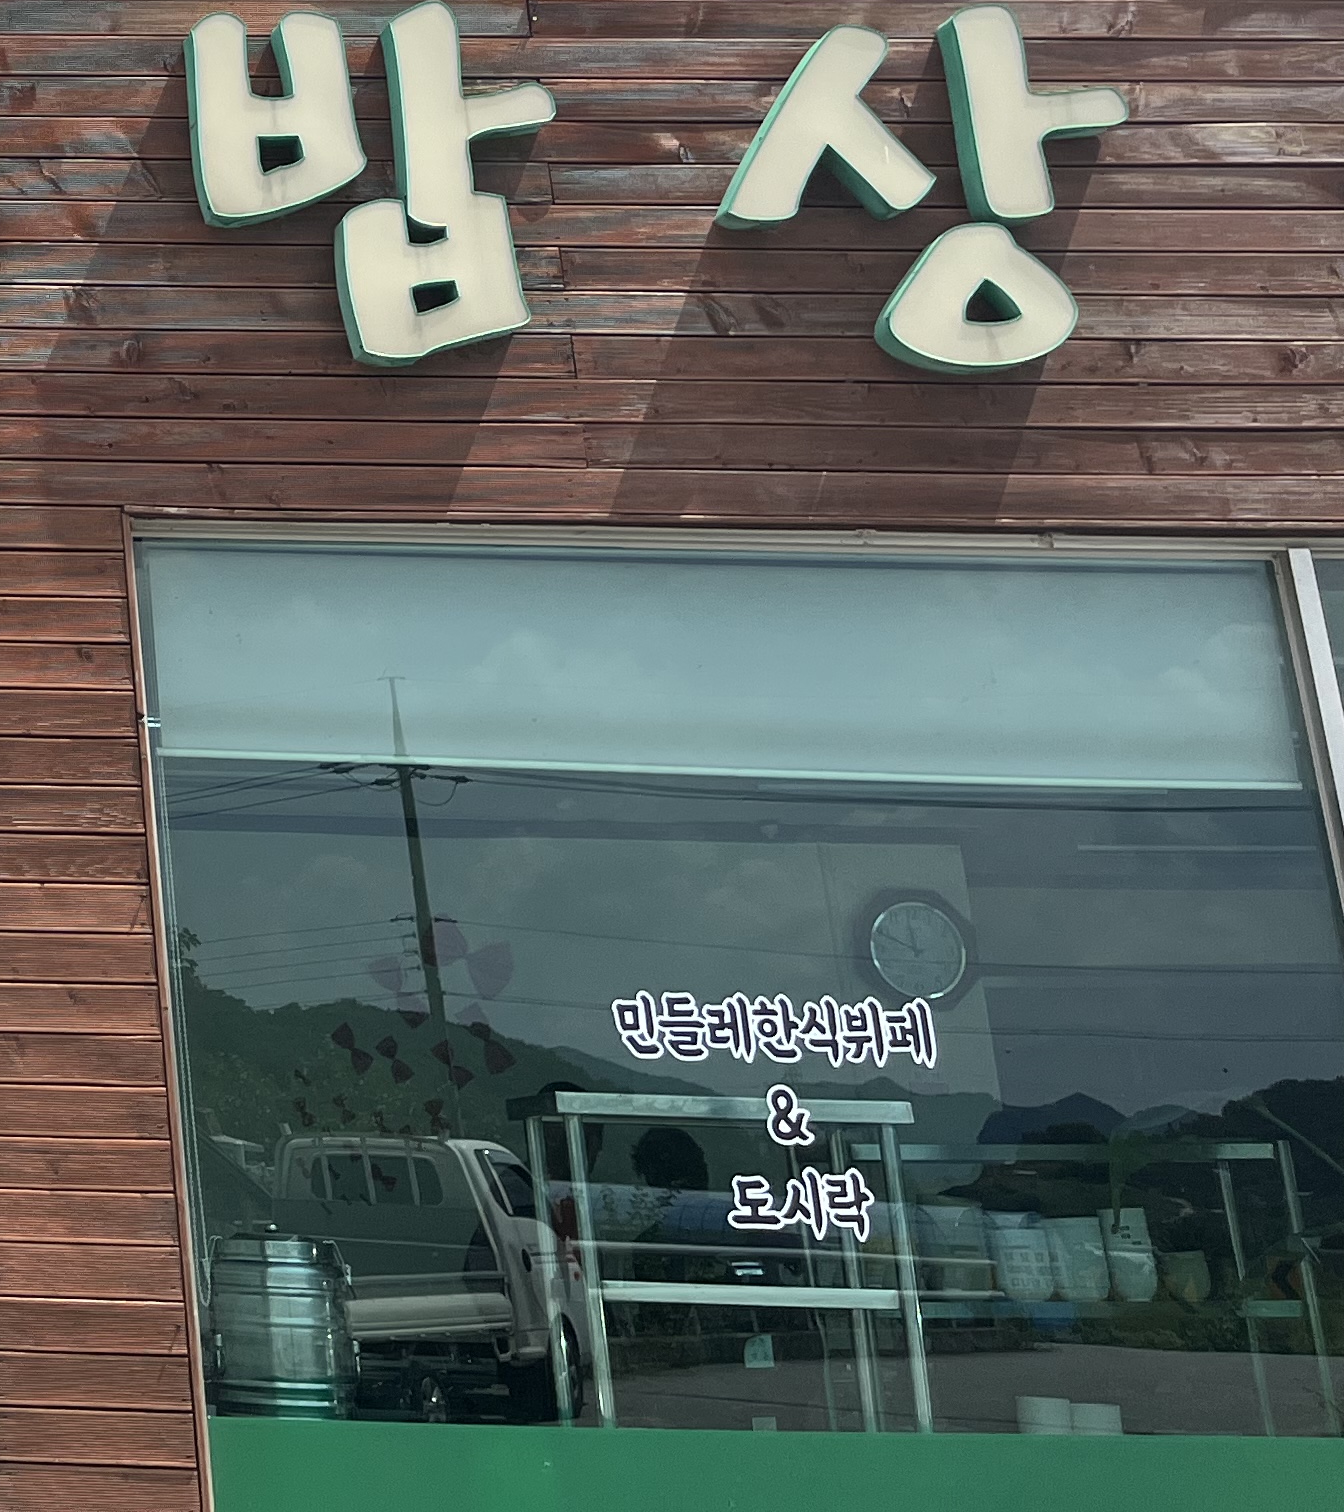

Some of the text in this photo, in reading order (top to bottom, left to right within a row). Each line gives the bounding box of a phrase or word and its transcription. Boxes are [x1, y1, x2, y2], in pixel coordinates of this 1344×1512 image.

[612, 991, 937, 1069] 민들레한식뷔페
[766, 1084, 815, 1146] &
[727, 1166, 874, 1243] 도시락
